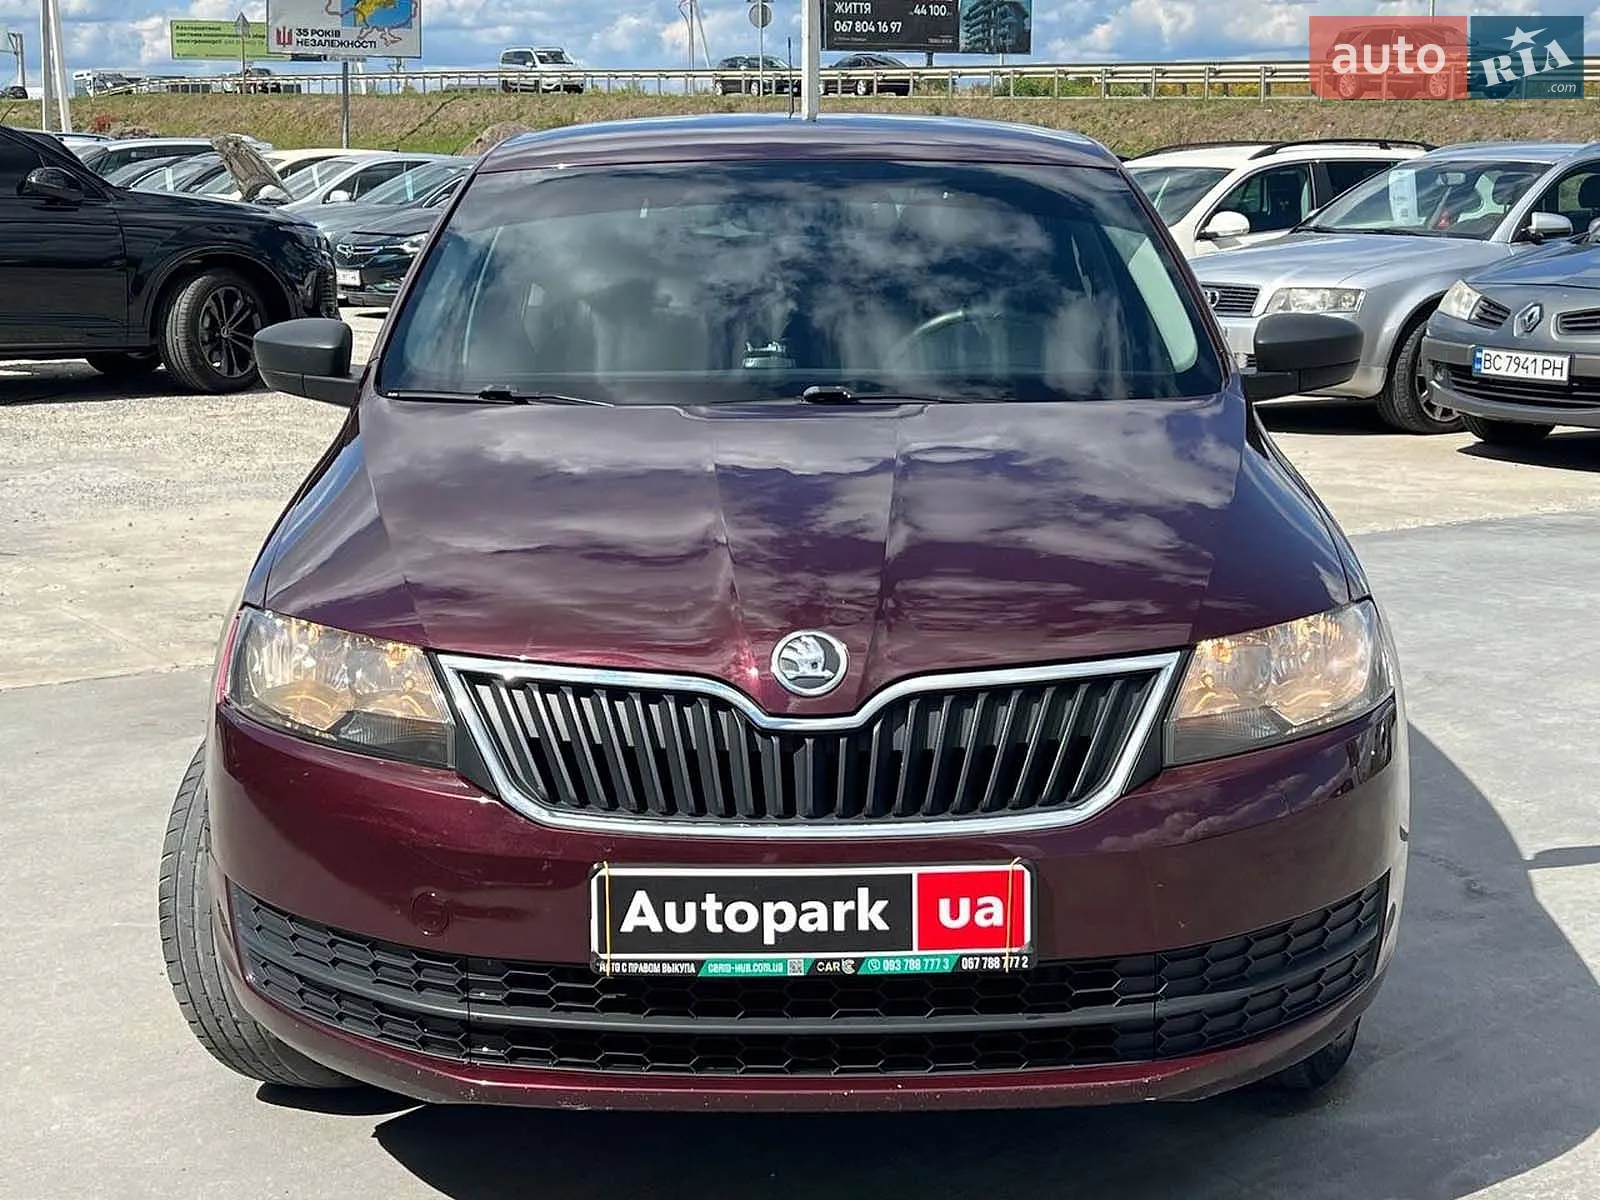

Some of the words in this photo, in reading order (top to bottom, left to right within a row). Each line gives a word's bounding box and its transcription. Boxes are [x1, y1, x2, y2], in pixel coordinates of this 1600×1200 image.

[834, 2, 871, 14] ЖИТТЯ
[913, 4, 927, 15] 44
[929, 4, 947, 16] 100
[296, 28, 309, 37] 35
[311, 28, 341, 38] РОКІВ
[834, 21, 853, 32] 067
[855, 21, 875, 32] 804
[877, 21, 888, 33] 16
[890, 21, 902, 33] 97
[296, 39, 377, 49] НЕЗАЛЕЖНОСТІ
[1505, 355, 1537, 375] 7941
[619, 886, 889, 945] Autopark
[938, 894, 1004, 929] ua
[662, 962, 696, 974] ВЫКУПА
[923, 957, 941, 970] 777
[943, 957, 949, 970] 3
[962, 957, 979, 970] 067
[1022, 956, 1028, 968] 2
